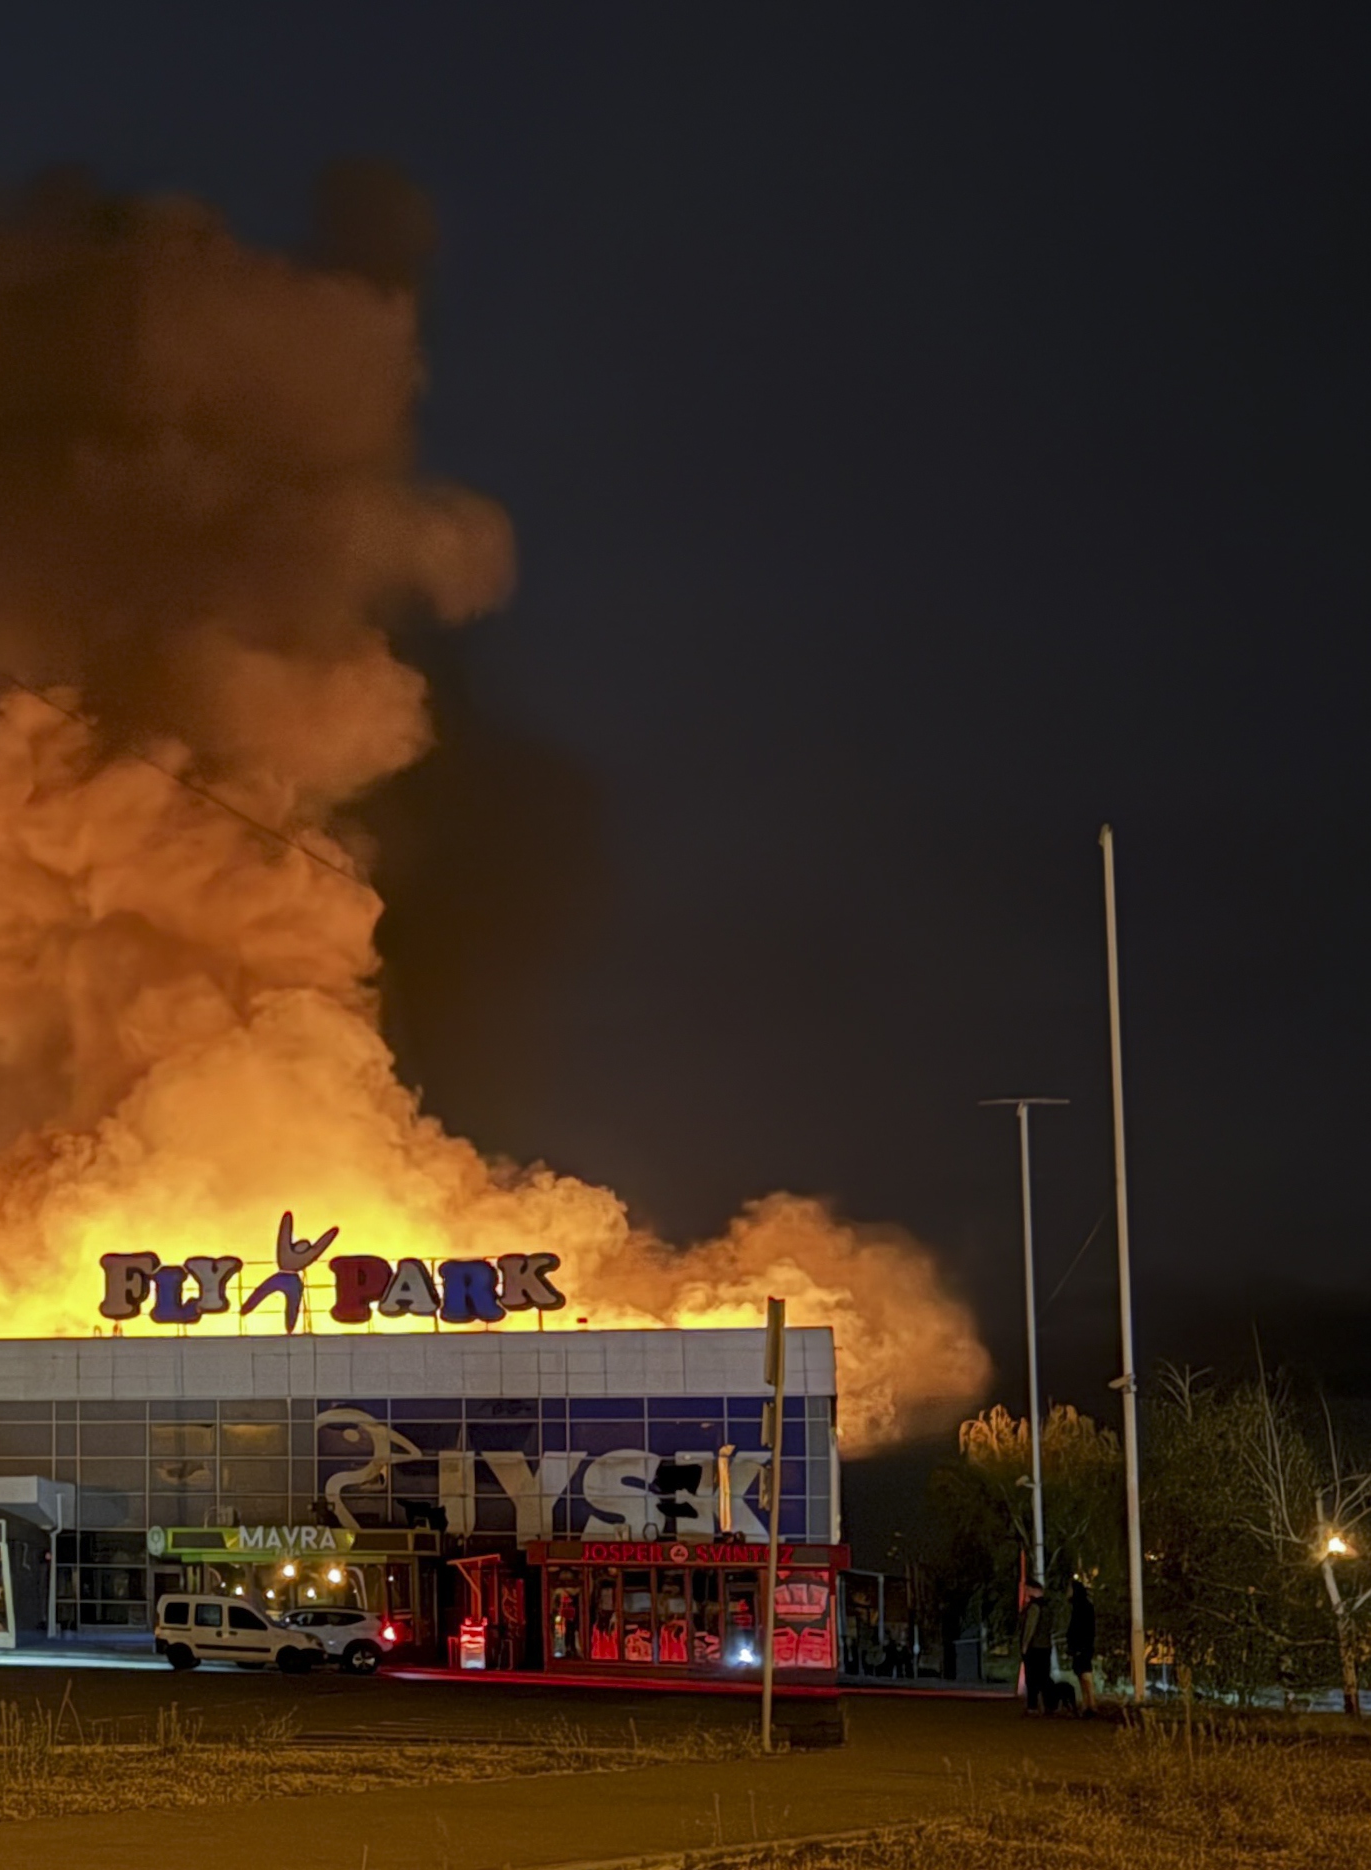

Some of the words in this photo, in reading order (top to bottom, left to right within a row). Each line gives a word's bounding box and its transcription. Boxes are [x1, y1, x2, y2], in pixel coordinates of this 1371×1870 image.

[100, 1252, 243, 1323] FLY
[329, 1252, 566, 1323] PARK
[238, 1525, 337, 1550] MAVRA
